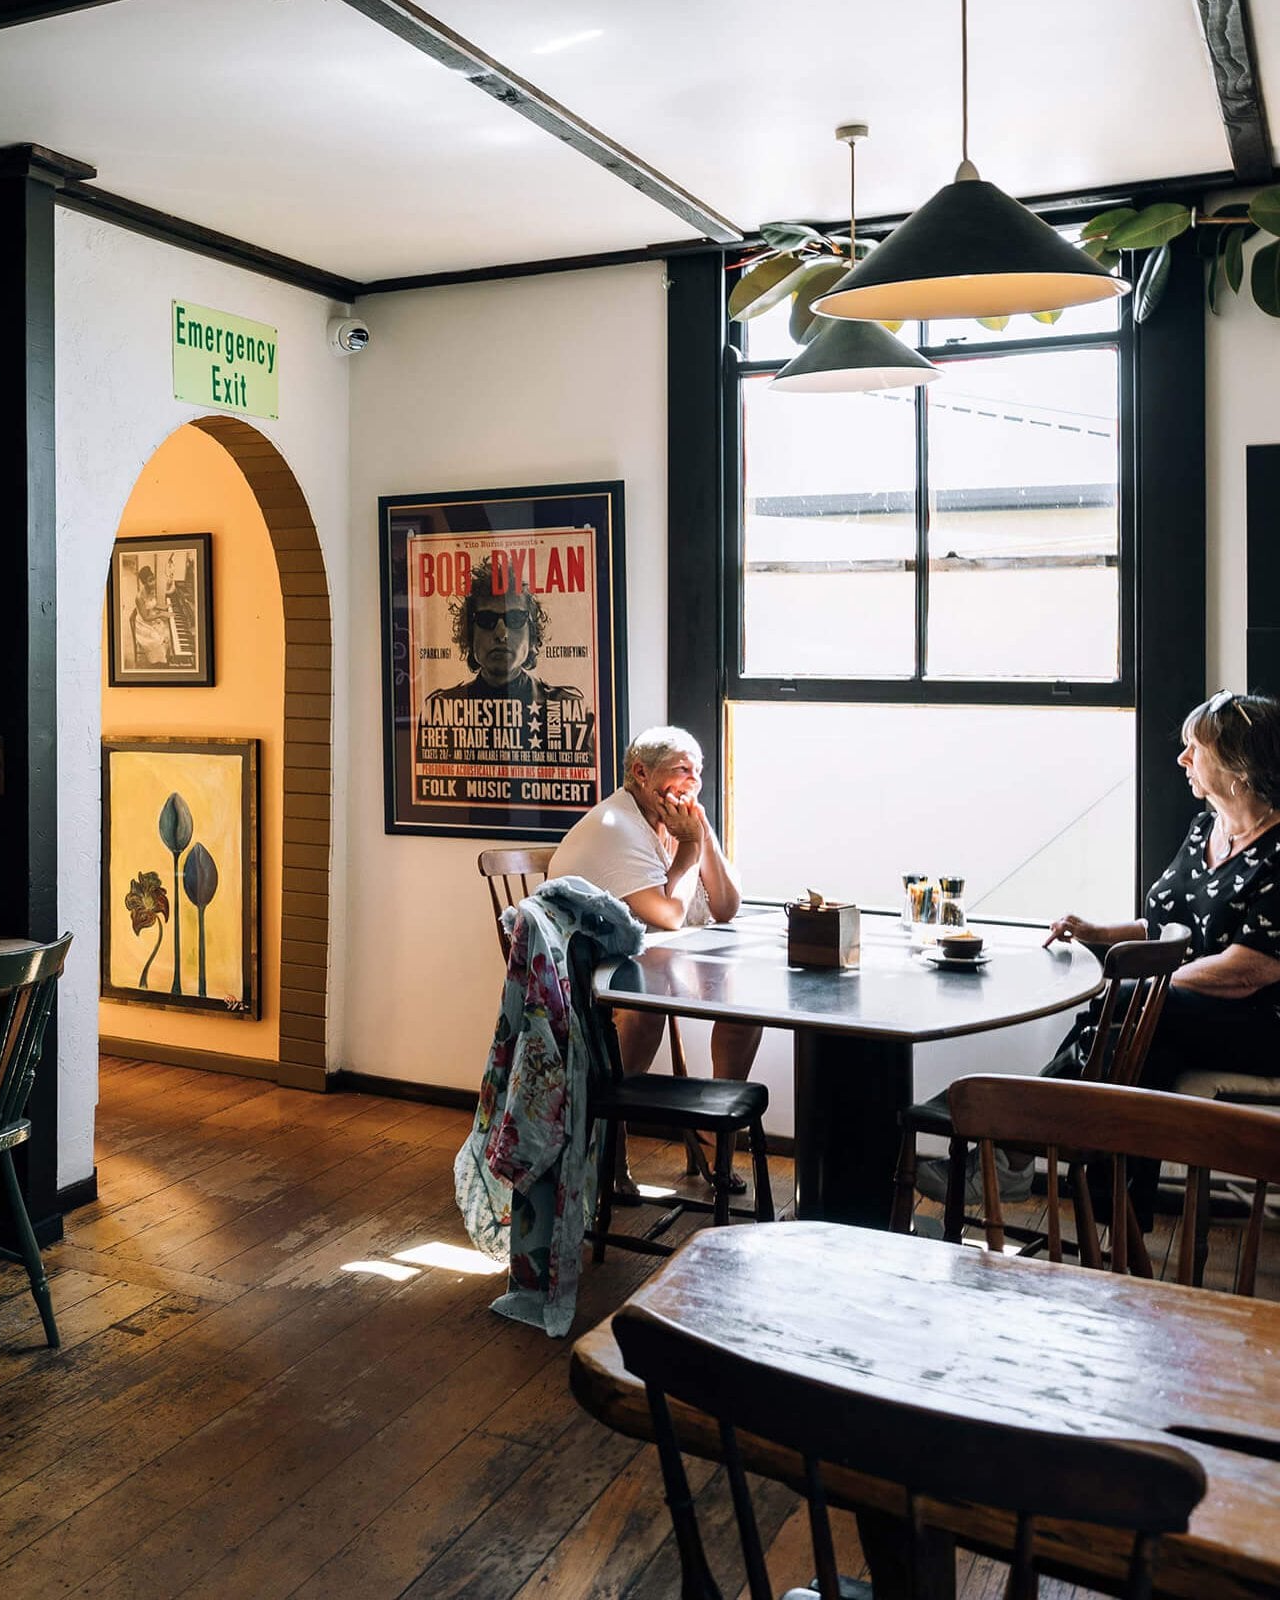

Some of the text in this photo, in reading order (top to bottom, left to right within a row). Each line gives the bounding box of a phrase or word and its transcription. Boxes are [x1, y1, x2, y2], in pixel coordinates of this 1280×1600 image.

[176, 306, 275, 373] Emergency
[212, 365, 247, 407] Exit
[419, 546, 585, 598] BOB DYLAN
[420, 648, 451, 660] SPARKLING!
[546, 646, 588, 658] ELECTRIFYING!
[421, 699, 523, 727] MANCHESTER
[546, 700, 561, 739] TUESDAY
[562, 700, 586, 722] MAY
[422, 727, 448, 748] FREE
[452, 728, 489, 749] TRADE
[494, 728, 523, 750] HALL
[563, 723, 587, 750] 17
[520, 751, 530, 762] FREE
[532, 751, 545, 762] TRADE
[547, 751, 558, 762] HALL
[559, 751, 573, 763] TICKET
[574, 752, 589, 763] OFFICE
[570, 768, 590, 780] HAWKS
[422, 779, 591, 802] FOLK MUSIC CONCERT
